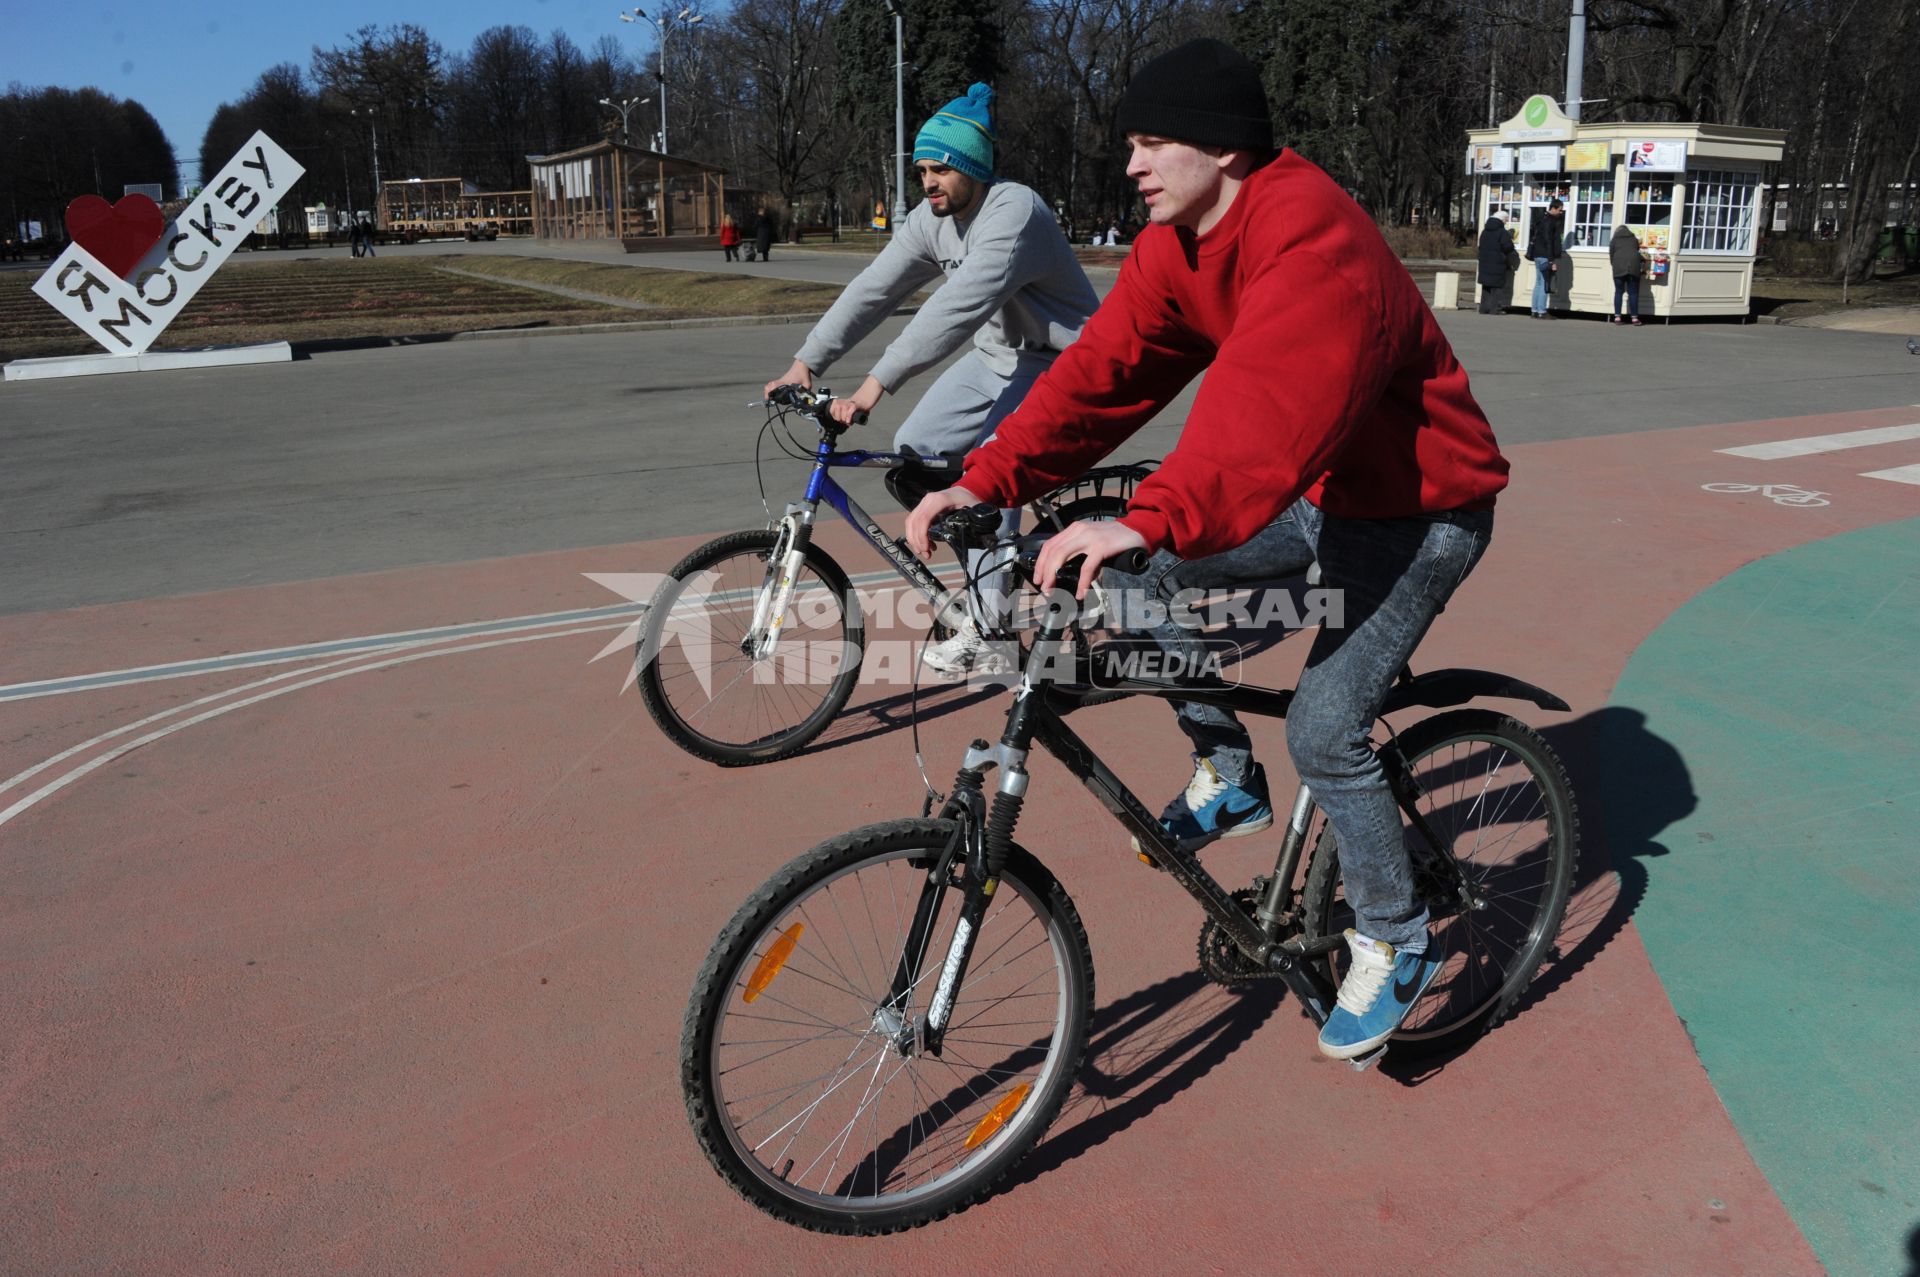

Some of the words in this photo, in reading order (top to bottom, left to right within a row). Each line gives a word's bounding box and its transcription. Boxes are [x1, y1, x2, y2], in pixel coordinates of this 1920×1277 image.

[99, 146, 274, 347] МОСКВУ
[56, 260, 110, 312] Я
[866, 524, 938, 597] UNIVEGA
[938, 917, 972, 996] SUNTOUR
